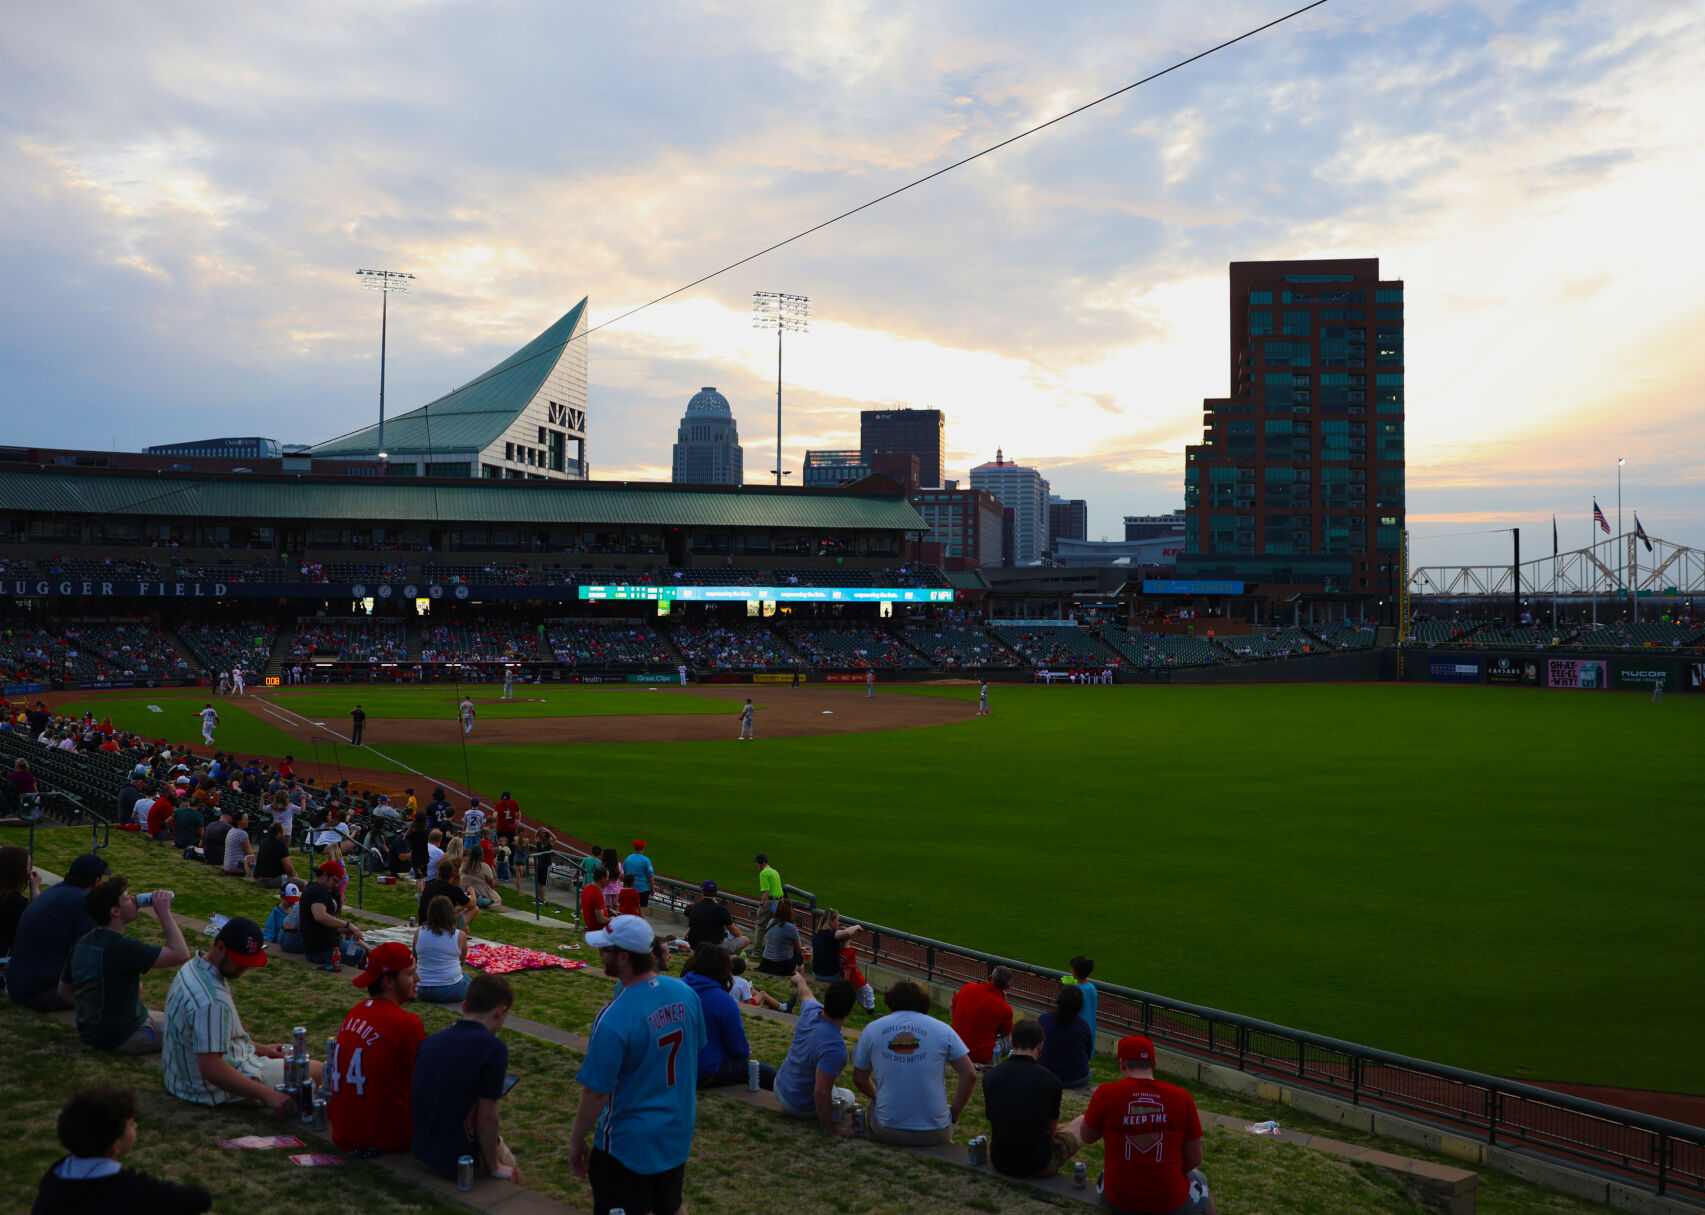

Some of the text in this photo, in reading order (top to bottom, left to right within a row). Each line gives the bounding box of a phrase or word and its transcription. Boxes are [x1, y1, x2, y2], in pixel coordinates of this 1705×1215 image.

[0, 582, 227, 596] LUGGER FIELD
[938, 591, 952, 600] MPH
[1551, 661, 1578, 670] OH-AY-
[637, 674, 655, 682] Great
[471, 816, 477, 826] 2
[648, 1002, 686, 1032] TURNER
[657, 1027, 684, 1088] 7
[1123, 1113, 1168, 1125] KEEP THE
